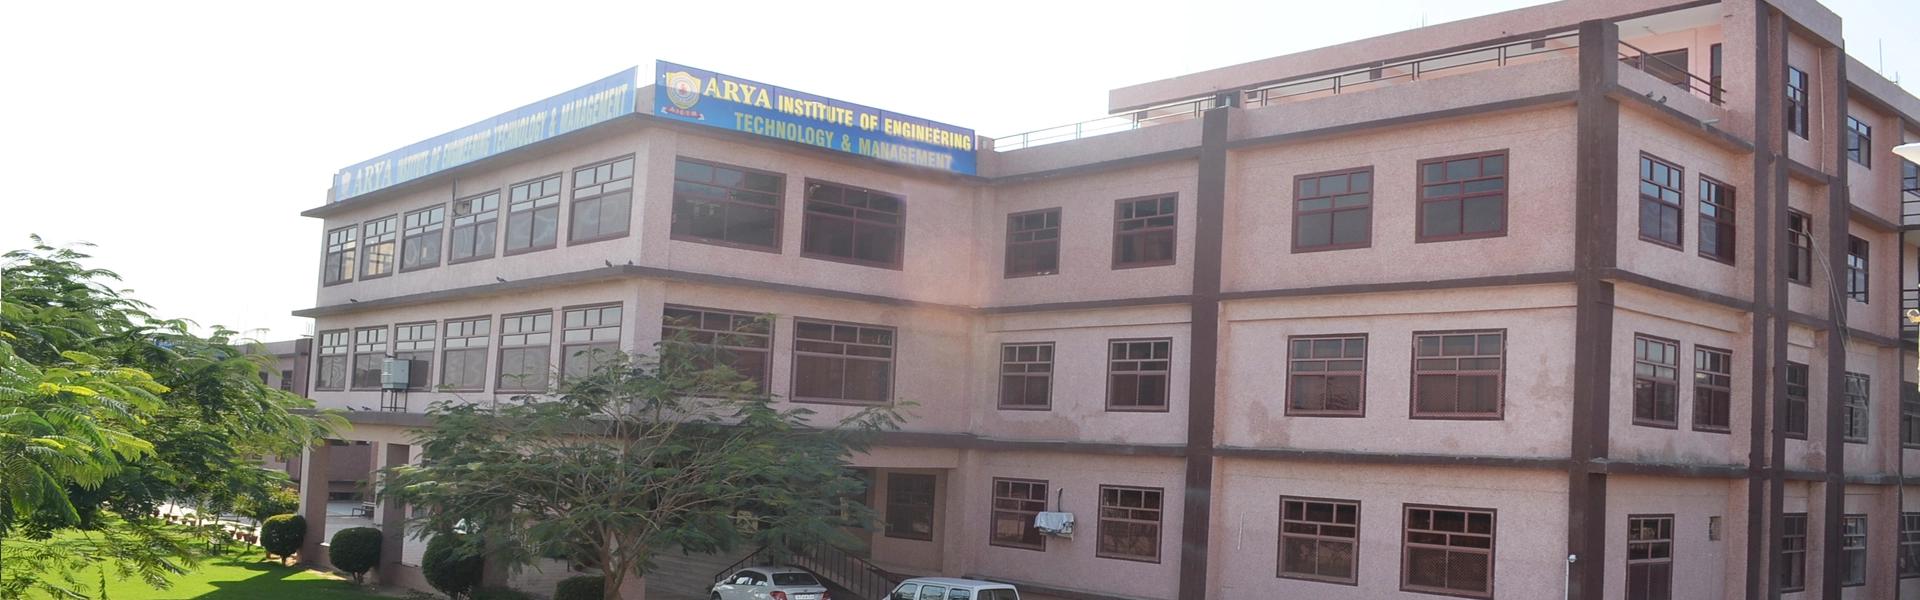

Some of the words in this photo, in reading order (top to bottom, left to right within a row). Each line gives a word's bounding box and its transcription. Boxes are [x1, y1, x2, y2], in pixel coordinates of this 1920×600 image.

[352, 159, 393, 196] ARYA
[493, 111, 548, 155] TECHNOLOGY
[559, 83, 628, 135] MANAGEMENT
[703, 77, 773, 110] ARYA
[778, 95, 854, 127] INSTITUTE
[859, 112, 879, 132] OF
[884, 117, 972, 152] ENGINEERING
[734, 111, 834, 149] TECHNOLOGY
[841, 134, 851, 153] &
[858, 137, 953, 171] MANAGEMENT
